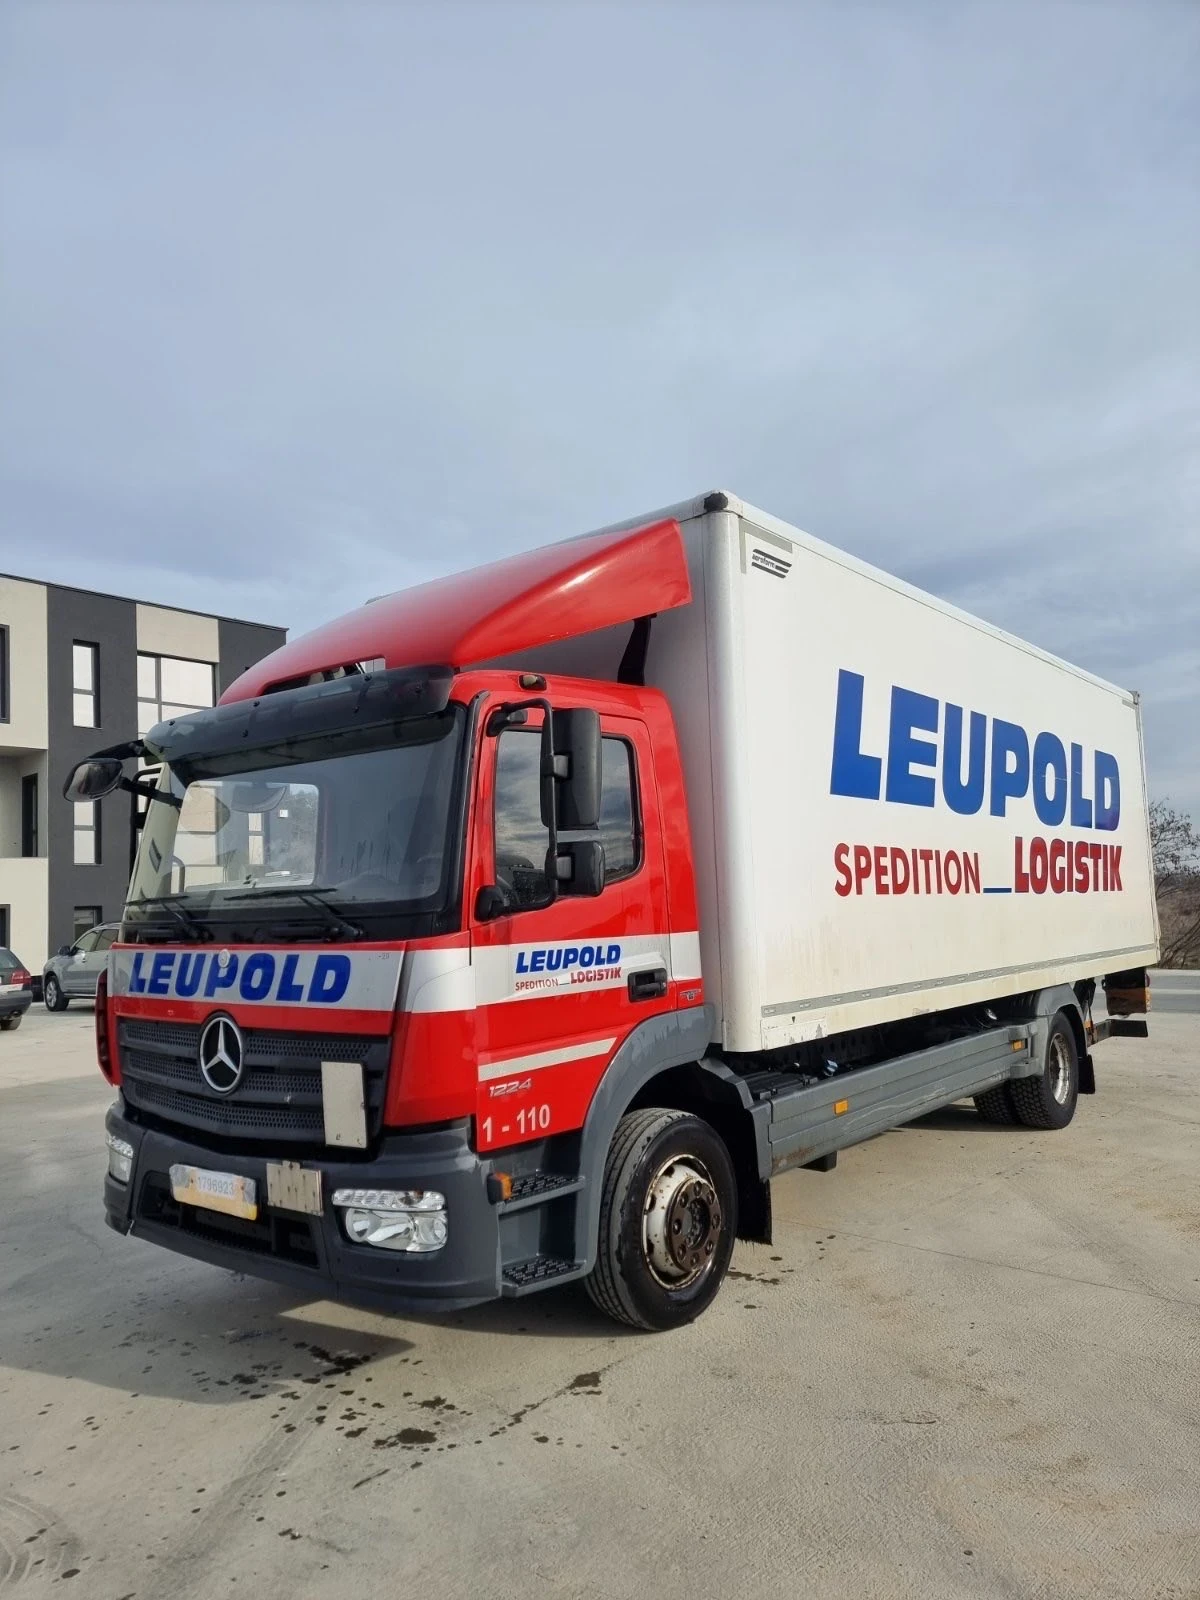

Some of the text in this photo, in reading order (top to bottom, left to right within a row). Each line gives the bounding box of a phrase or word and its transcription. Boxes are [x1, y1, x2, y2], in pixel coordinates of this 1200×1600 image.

[830, 668, 1121, 831] LEUPOLD
[834, 836, 1123, 897] SPEDITION LOGISTIK
[129, 952, 351, 1003] LEUPOLD
[515, 944, 621, 974] LEUPOLD
[515, 967, 622, 991] SPEDITION LOGISTIK
[489, 1078, 532, 1097] 1224
[482, 1116, 492, 1143] 1
[516, 1104, 551, 1134] 110
